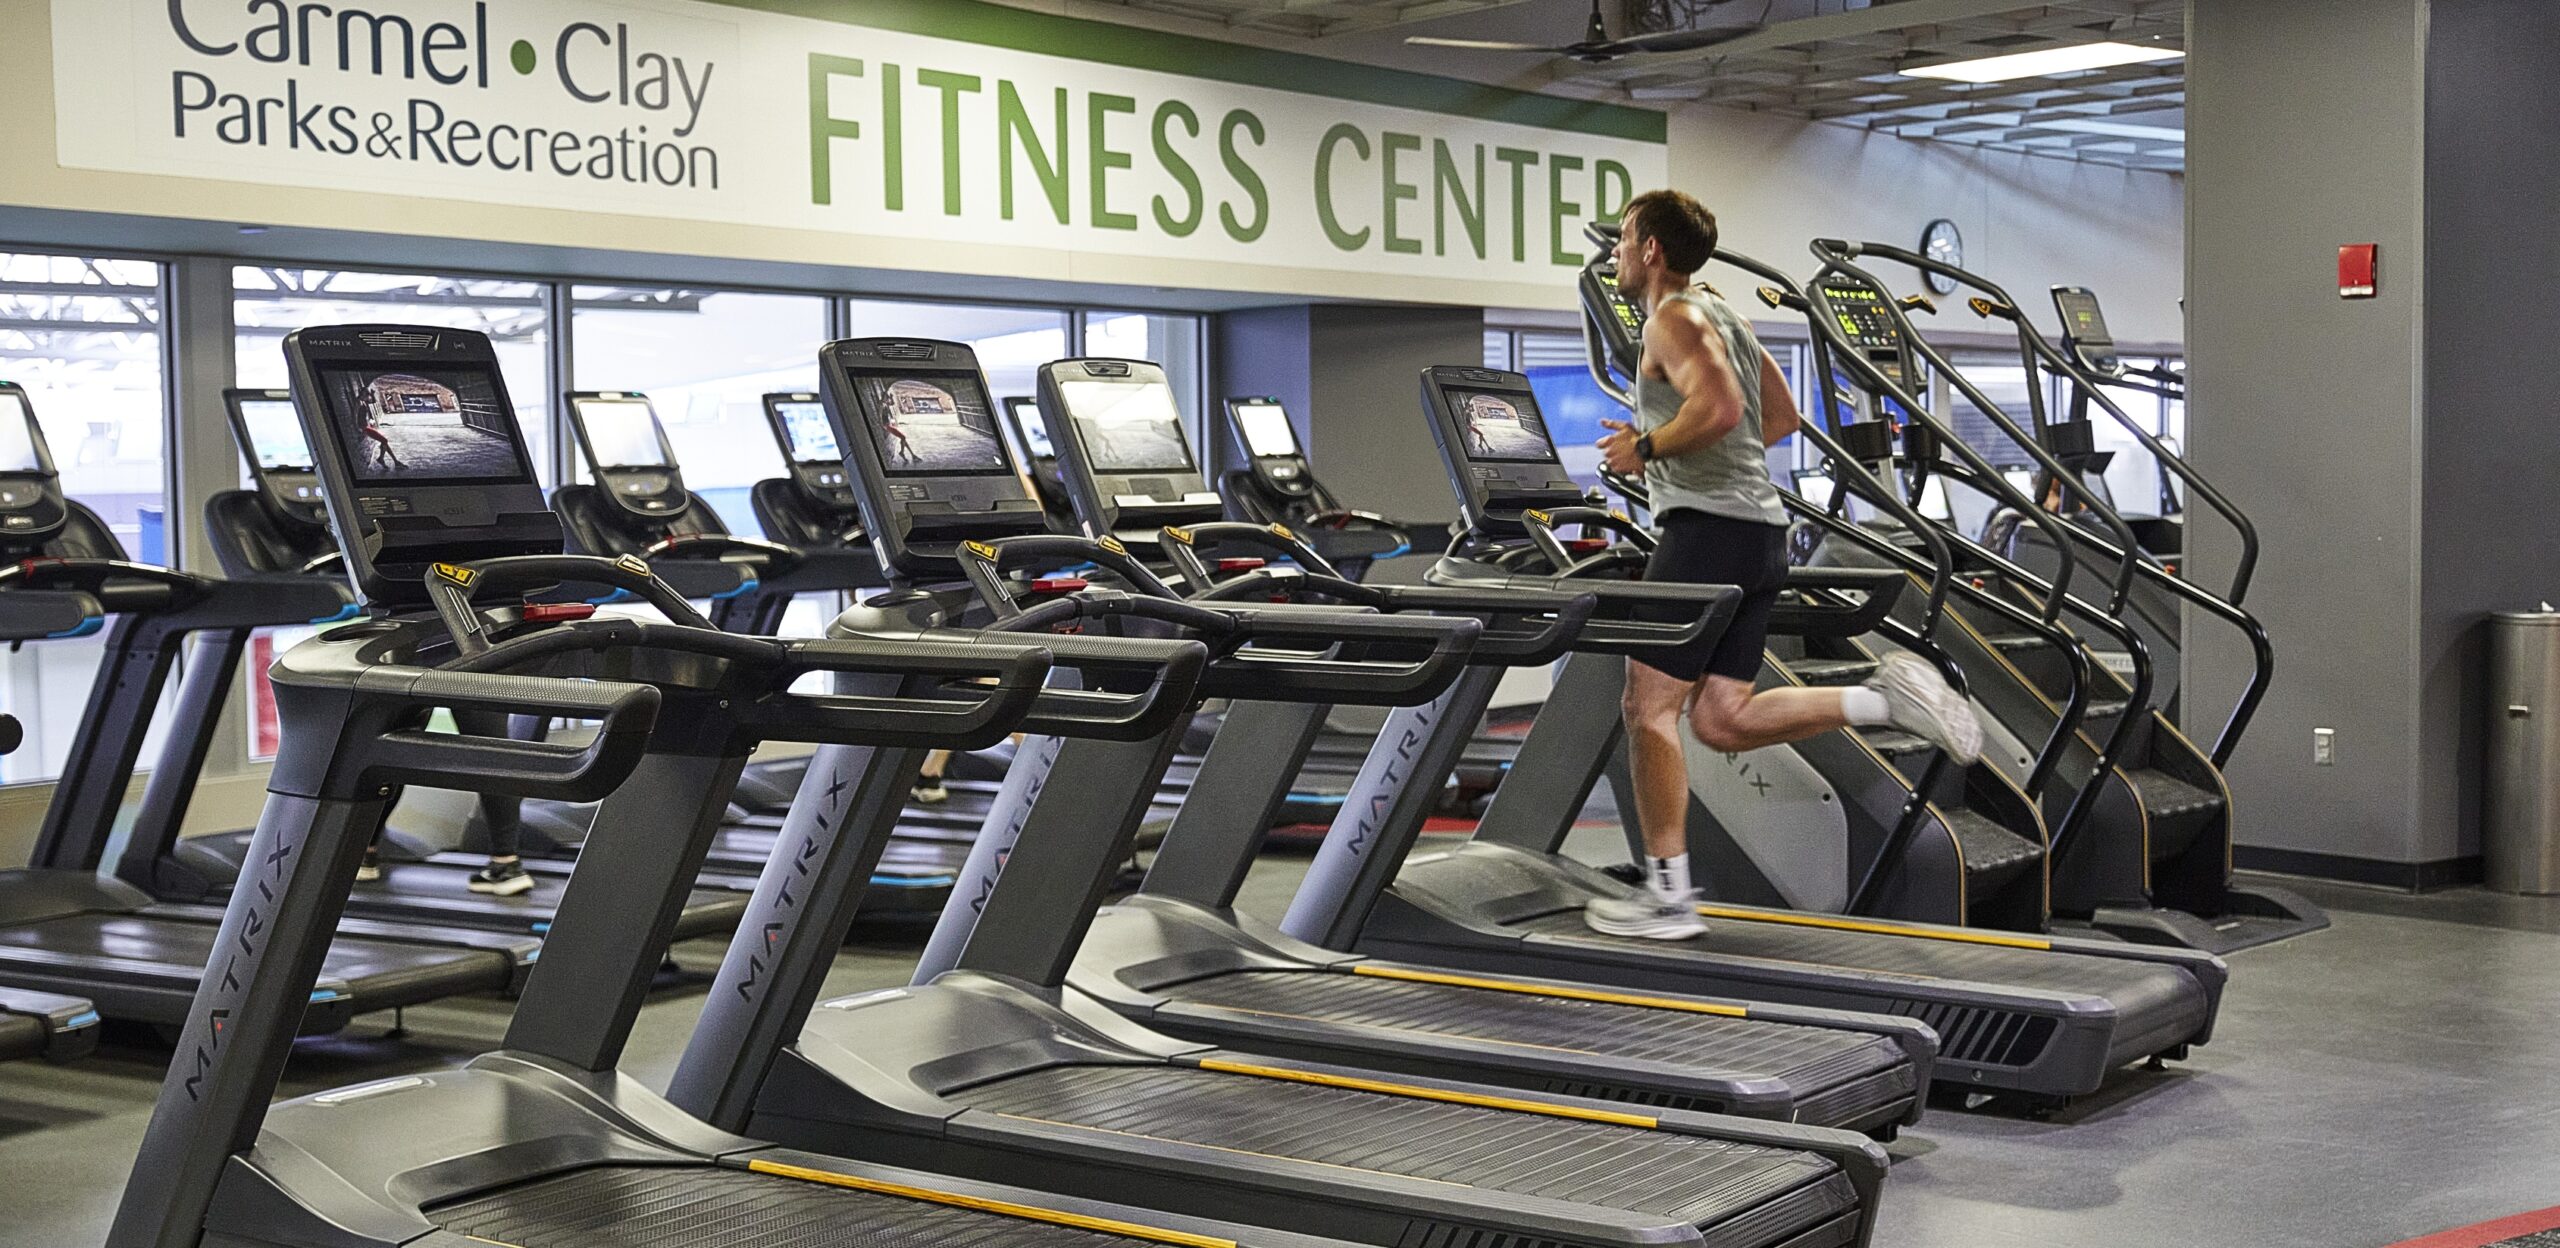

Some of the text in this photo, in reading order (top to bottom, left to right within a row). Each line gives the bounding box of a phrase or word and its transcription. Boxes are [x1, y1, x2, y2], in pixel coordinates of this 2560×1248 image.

[167, 0, 714, 137] Carmel Clay
[808, 52, 1632, 266] FITNESS CENTER
[309, 339, 352, 347] MATRIX
[185, 829, 292, 1101] MATRIX
[737, 767, 849, 1003] MATRIX
